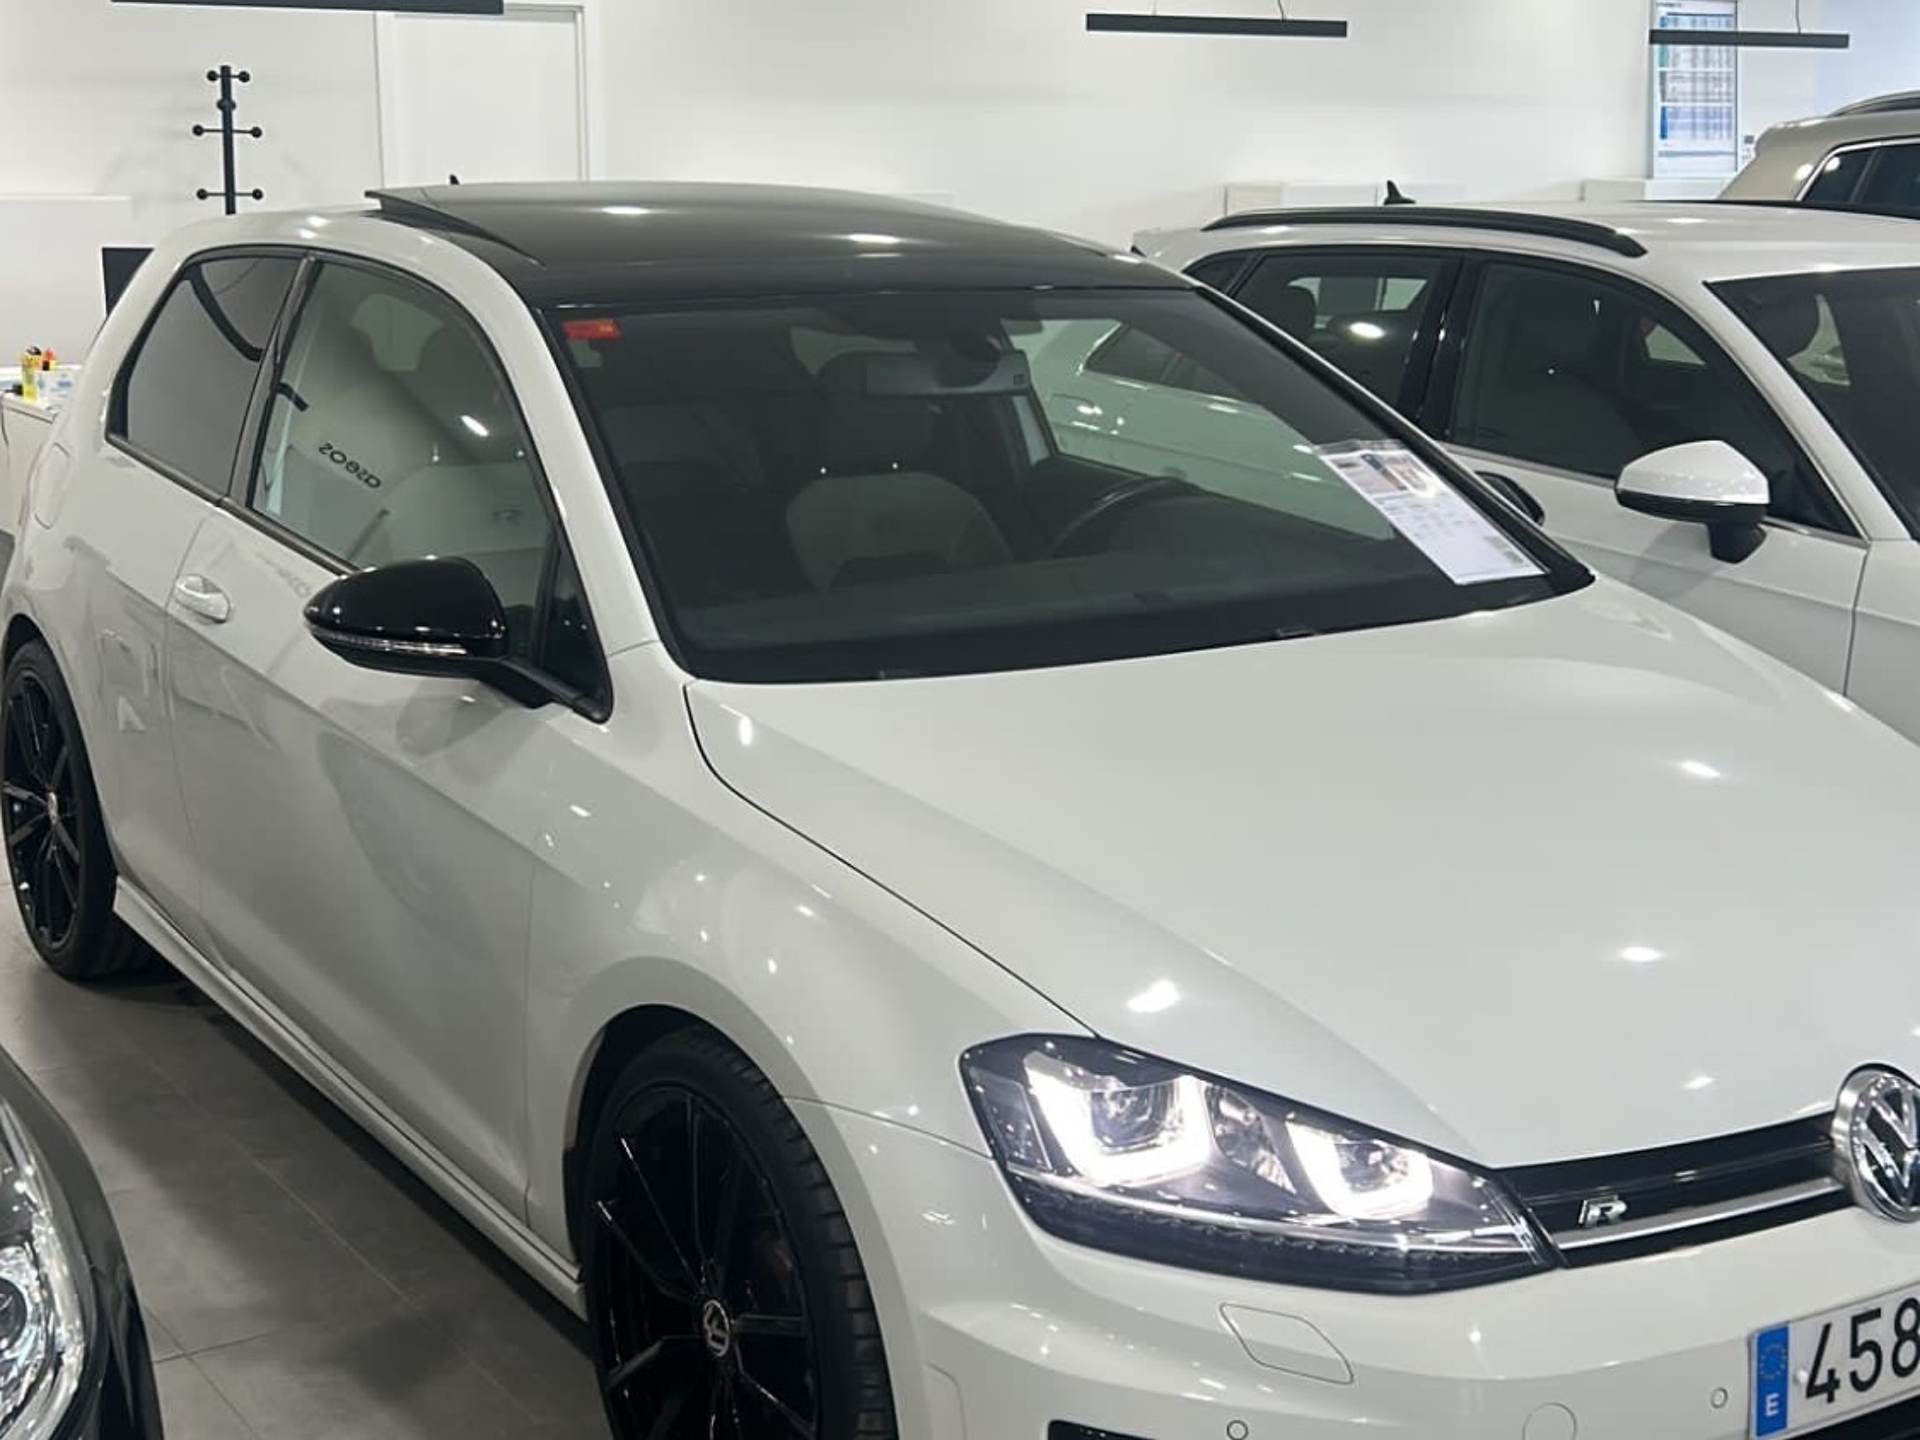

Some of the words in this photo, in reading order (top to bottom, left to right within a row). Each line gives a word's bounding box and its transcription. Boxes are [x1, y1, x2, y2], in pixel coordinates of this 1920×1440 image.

[1579, 1194, 1627, 1227] R
[1805, 1297, 1920, 1404] 458
[1765, 1392, 1780, 1417] E
